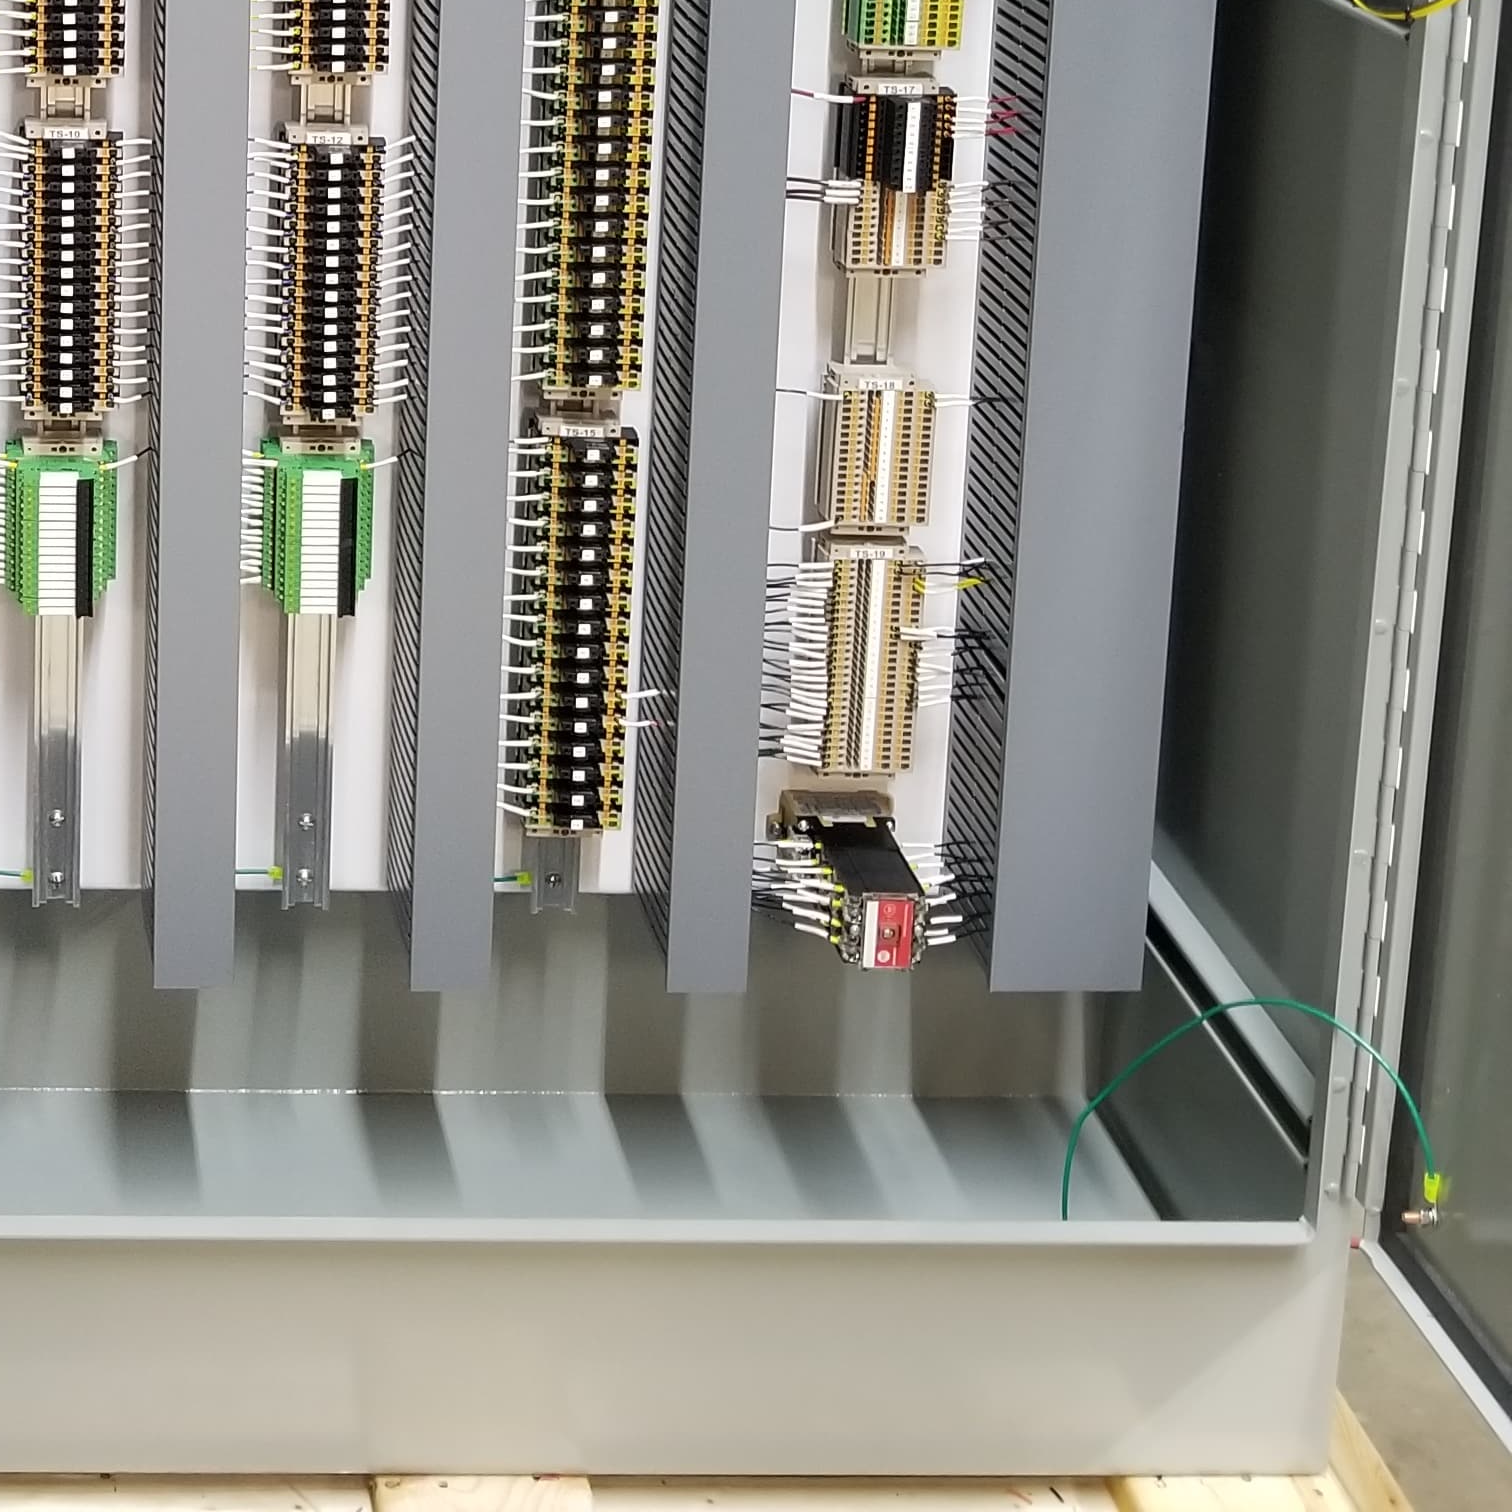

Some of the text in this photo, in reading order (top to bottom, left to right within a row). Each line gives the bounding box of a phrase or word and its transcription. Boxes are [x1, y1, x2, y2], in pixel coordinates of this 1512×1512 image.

[883, 85, 916, 95] TS-17
[49, 130, 80, 138] TS-10
[311, 135, 343, 144] TS-12
[864, 380, 895, 389] TS-18
[565, 428, 596, 437] TS-15
